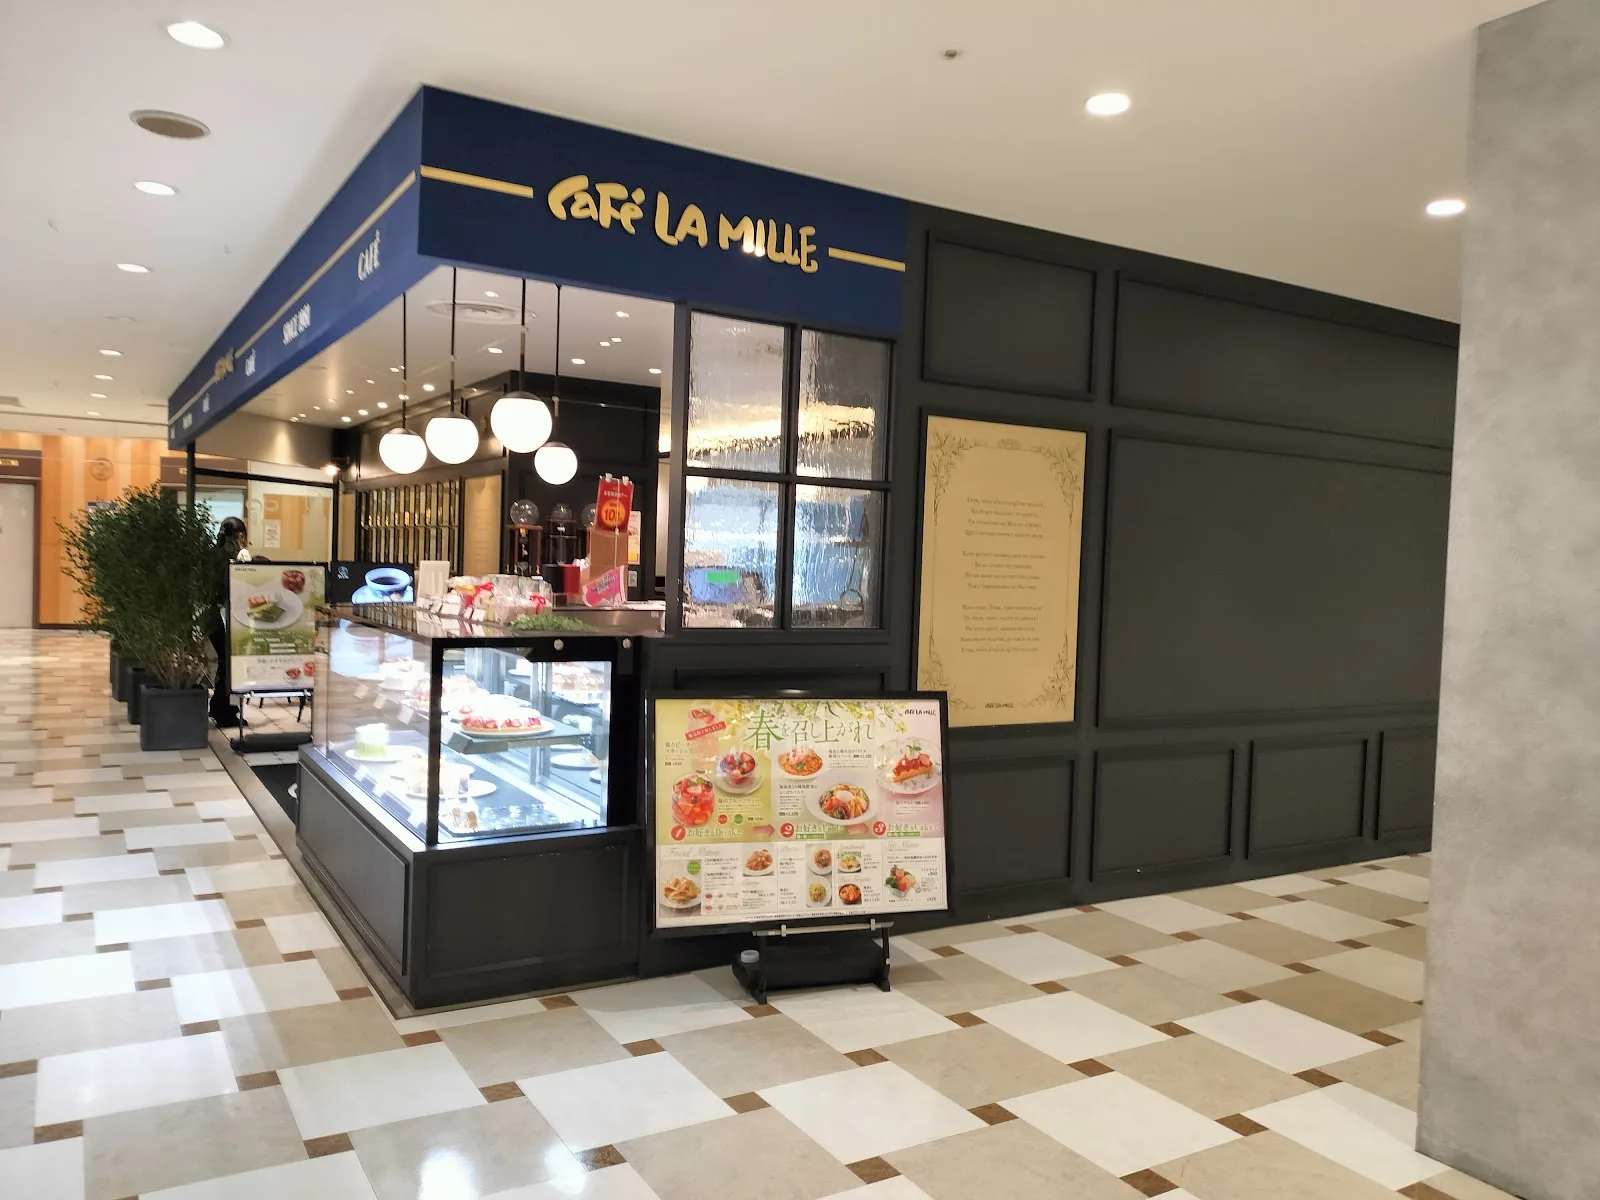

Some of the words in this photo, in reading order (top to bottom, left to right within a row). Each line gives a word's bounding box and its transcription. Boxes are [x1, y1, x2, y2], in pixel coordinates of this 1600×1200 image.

[655, 190, 708, 249] LA
[719, 213, 819, 274] MILLE
[742, 709, 875, 751] 春を召し上がれ
